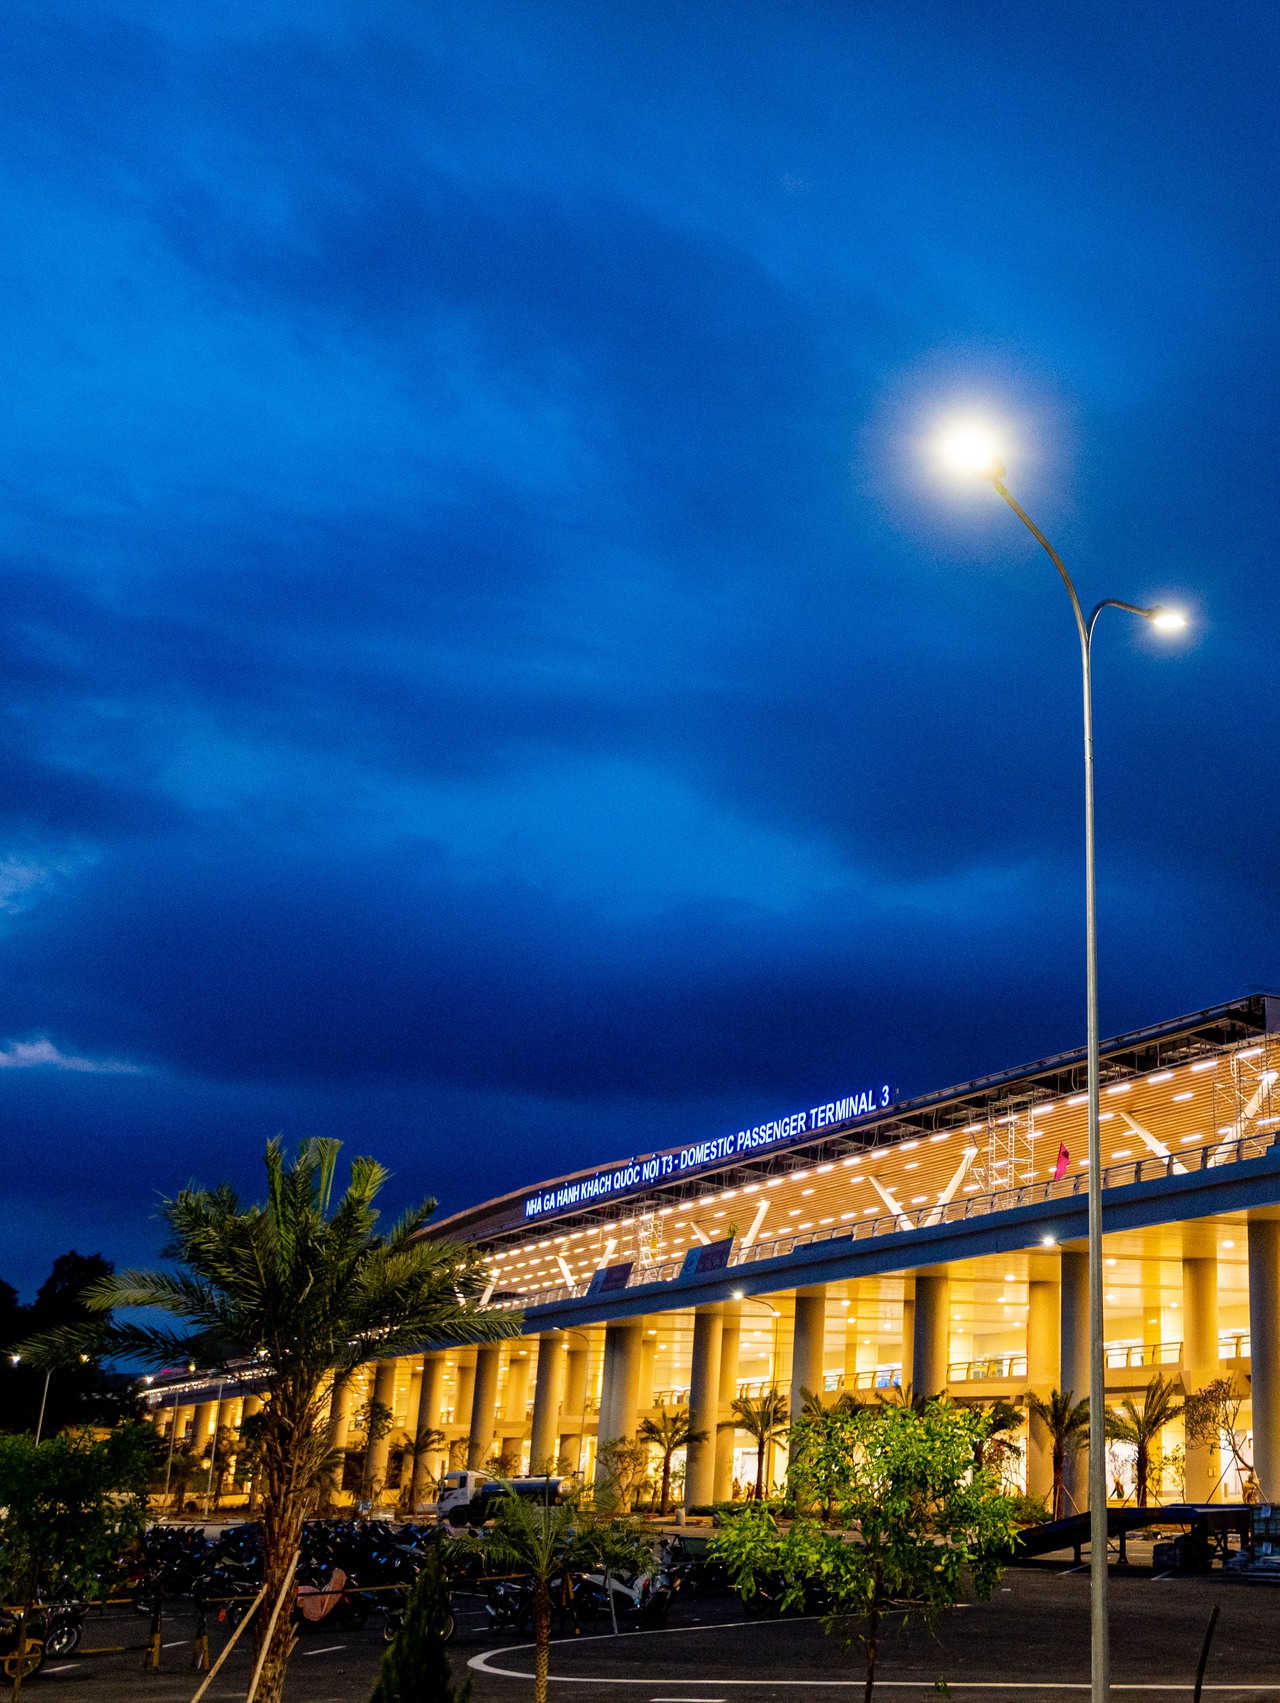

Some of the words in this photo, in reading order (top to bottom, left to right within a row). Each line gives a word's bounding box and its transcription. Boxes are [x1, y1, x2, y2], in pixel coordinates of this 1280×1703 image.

[544, 1194, 555, 1211] GA
[580, 1172, 612, 1200] KHÁCH
[613, 1157, 640, 1189] QUỐC
[642, 1153, 660, 1183] NỘI
[661, 1154, 673, 1175] T3
[680, 1135, 735, 1169] DOMESTIC
[737, 1112, 806, 1151] PASSENGER
[810, 1090, 877, 1129] TERMINAL
[881, 1085, 890, 1107] 3
